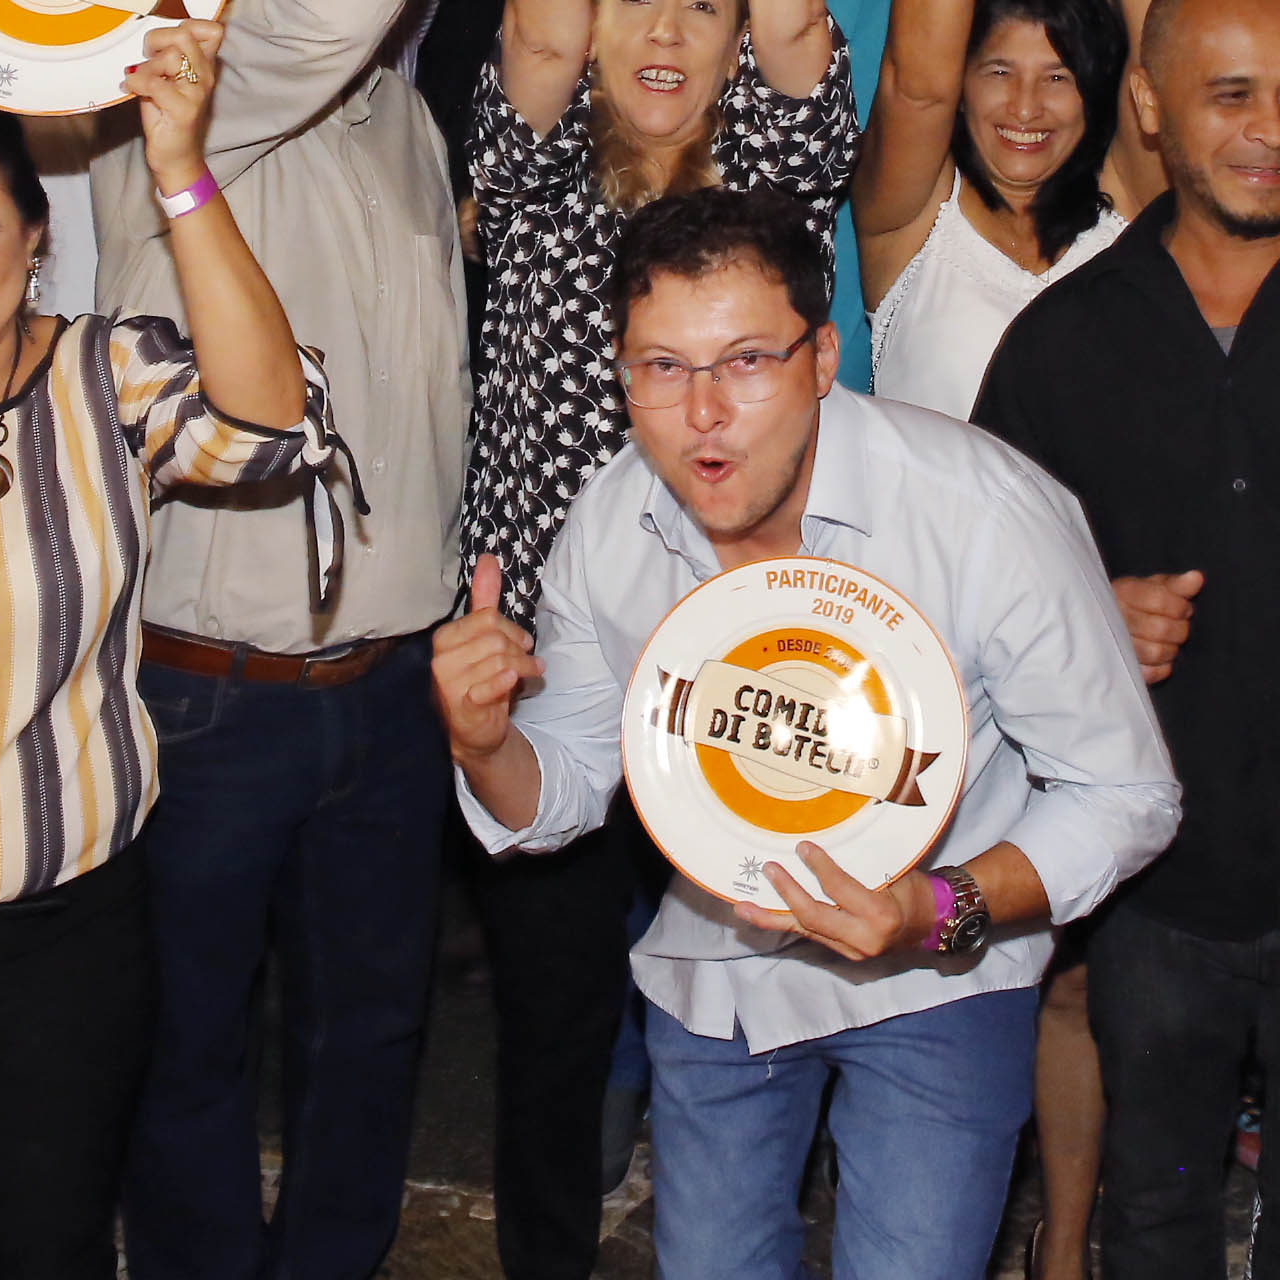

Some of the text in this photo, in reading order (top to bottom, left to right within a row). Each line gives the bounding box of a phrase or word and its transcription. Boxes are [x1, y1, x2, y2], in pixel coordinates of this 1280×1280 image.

[765, 570, 905, 632] PARTICIPANTE
[812, 598, 854, 625] 2019
[777, 639, 821, 655] DESDE
[707, 708, 746, 744] DI
